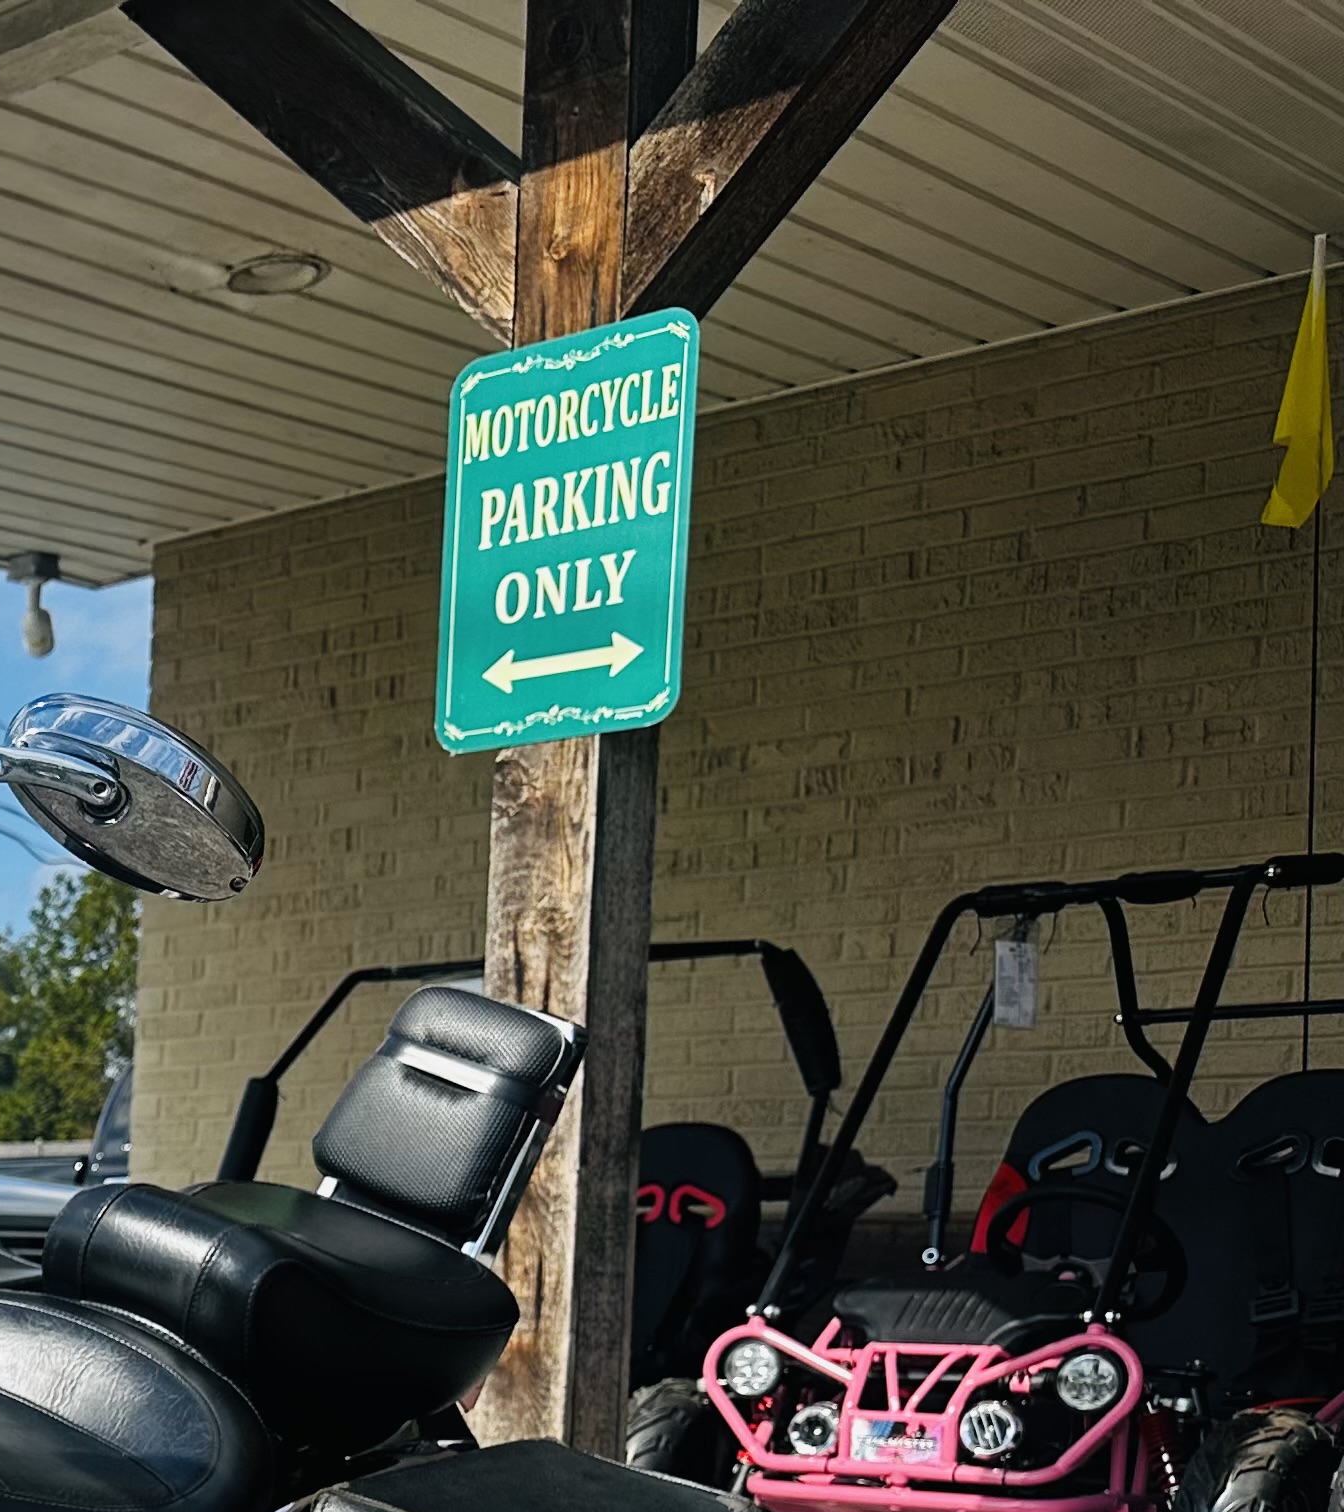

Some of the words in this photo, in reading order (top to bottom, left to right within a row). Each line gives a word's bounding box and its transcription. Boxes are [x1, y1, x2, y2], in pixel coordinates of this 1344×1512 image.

[463, 362, 681, 465] MOTORCYCLE
[478, 451, 672, 550] PARKING
[494, 549, 637, 624] ONLY
